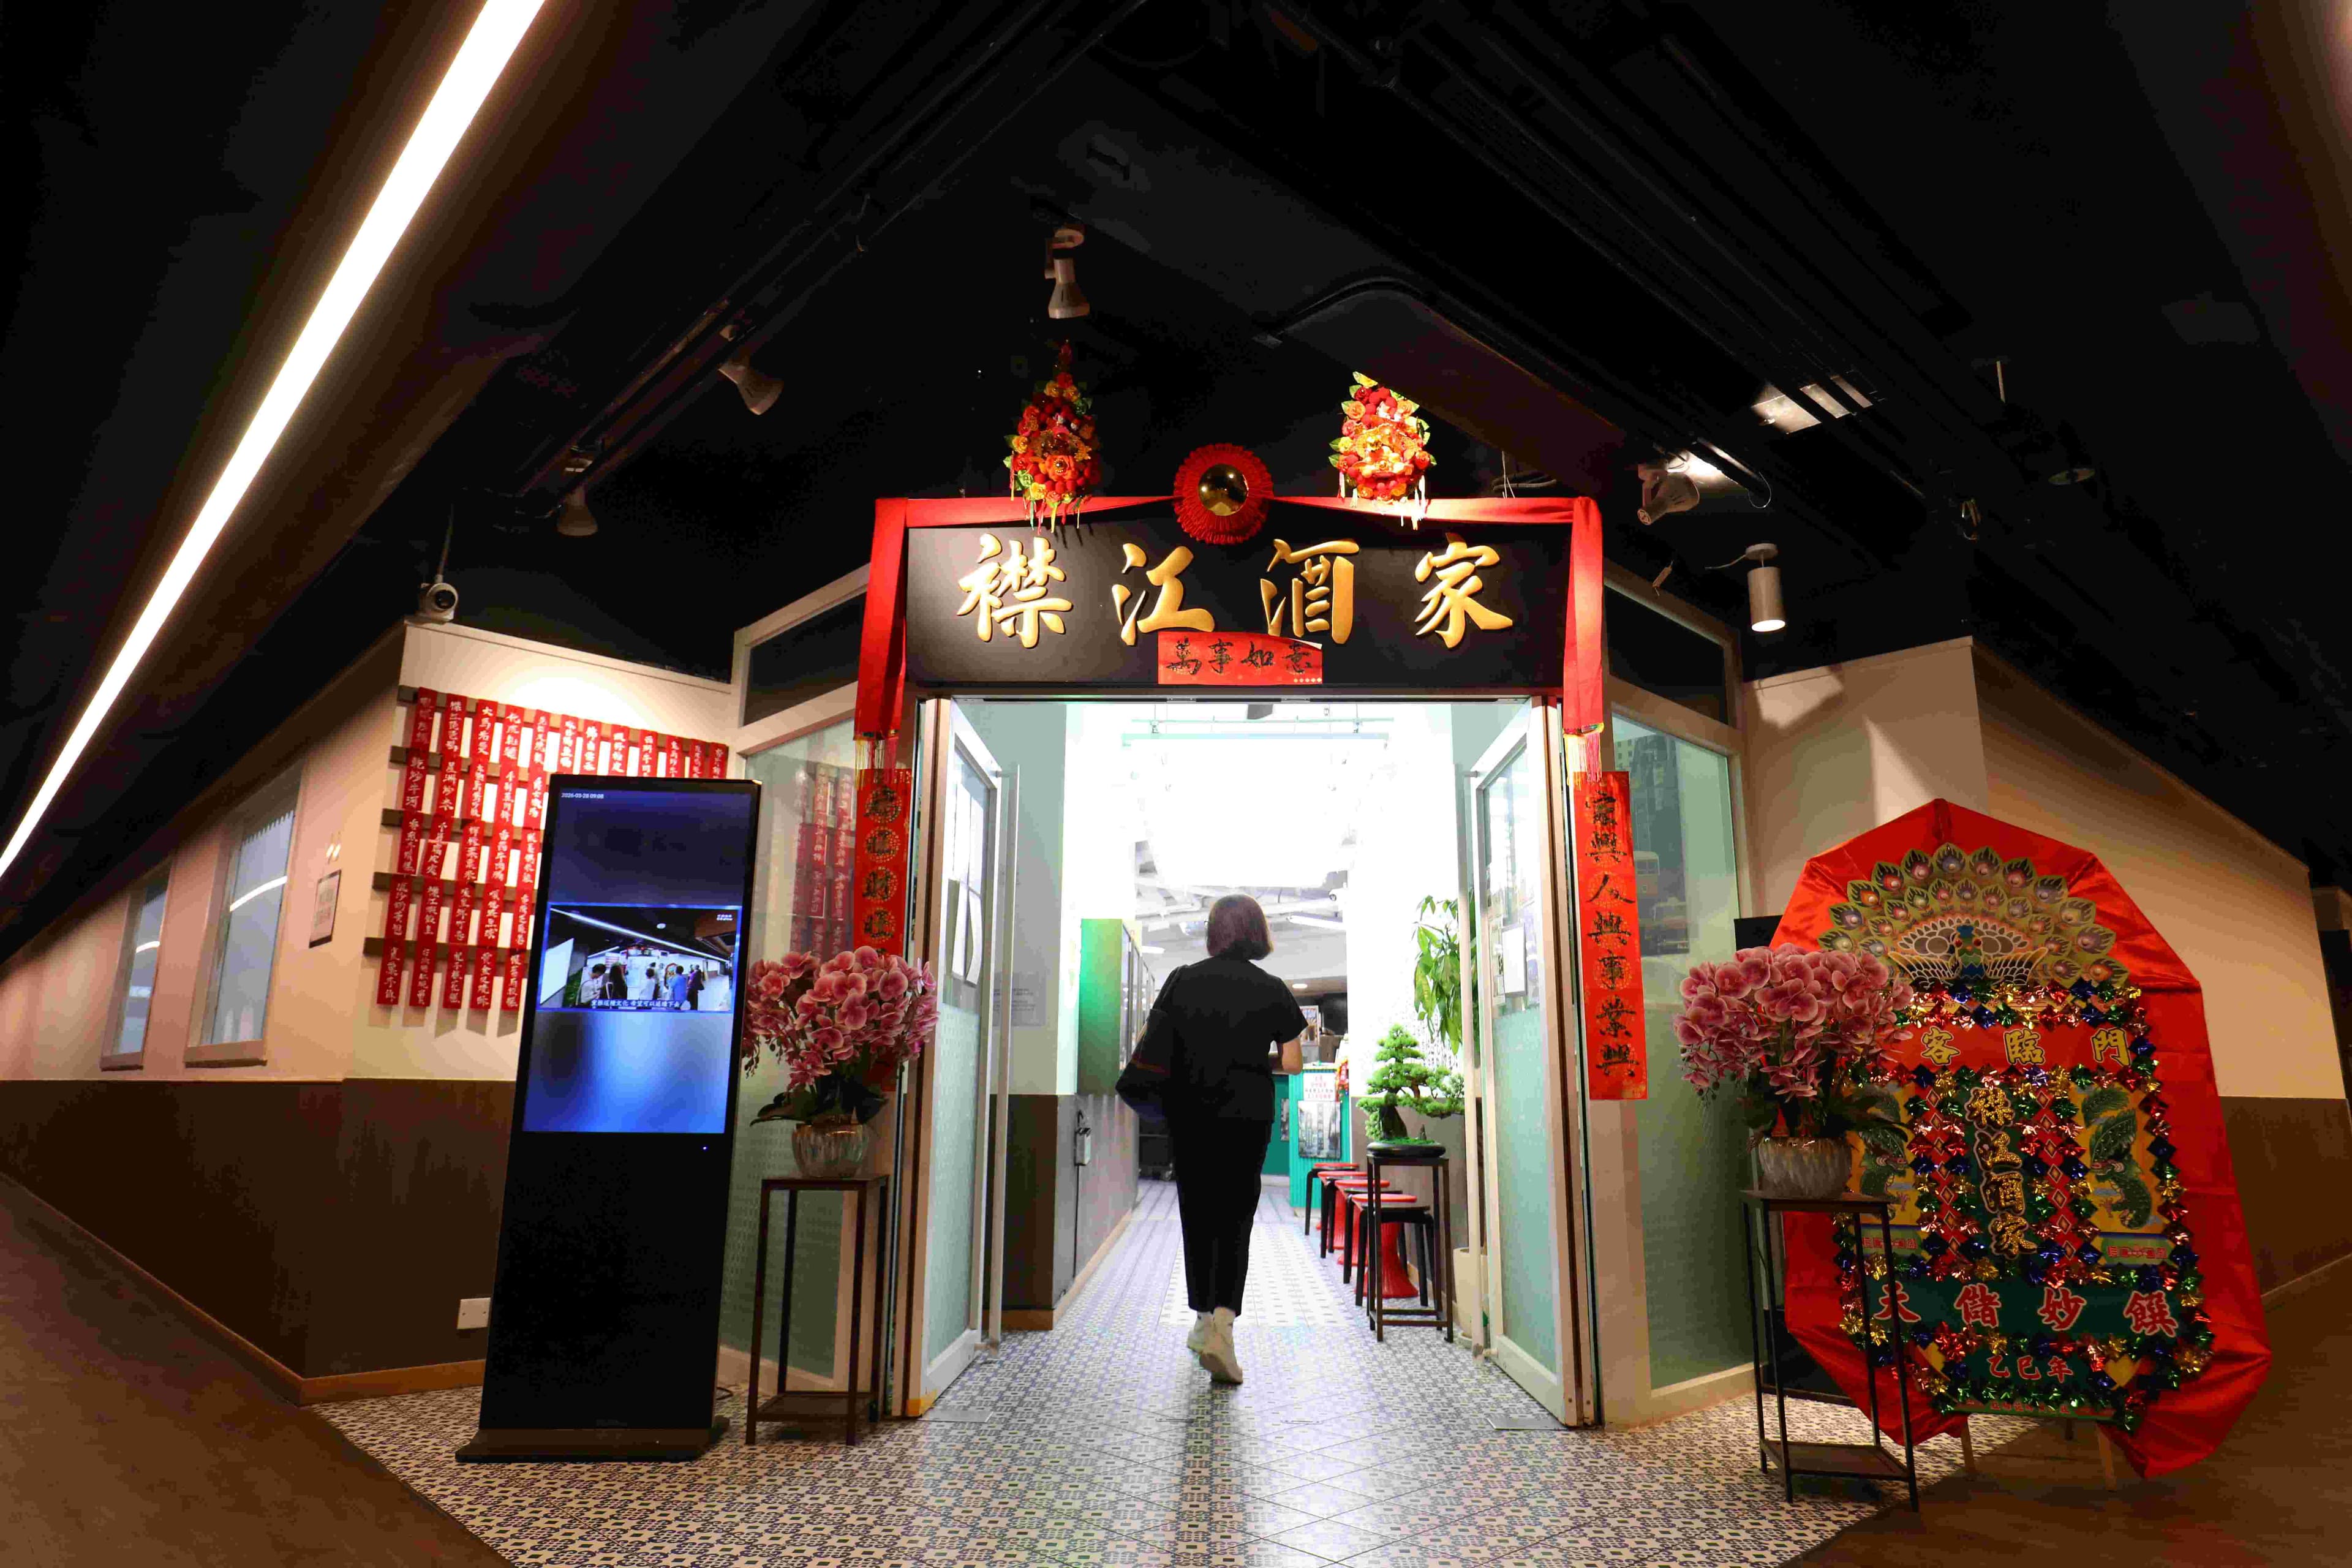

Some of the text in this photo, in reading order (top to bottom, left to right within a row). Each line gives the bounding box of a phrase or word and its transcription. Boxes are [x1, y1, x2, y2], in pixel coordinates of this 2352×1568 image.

[957, 532, 1514, 647] 襟江酒家
[1166, 636, 1313, 675] 萬事如意
[1988, 1355, 2074, 1383] 乙巳年
